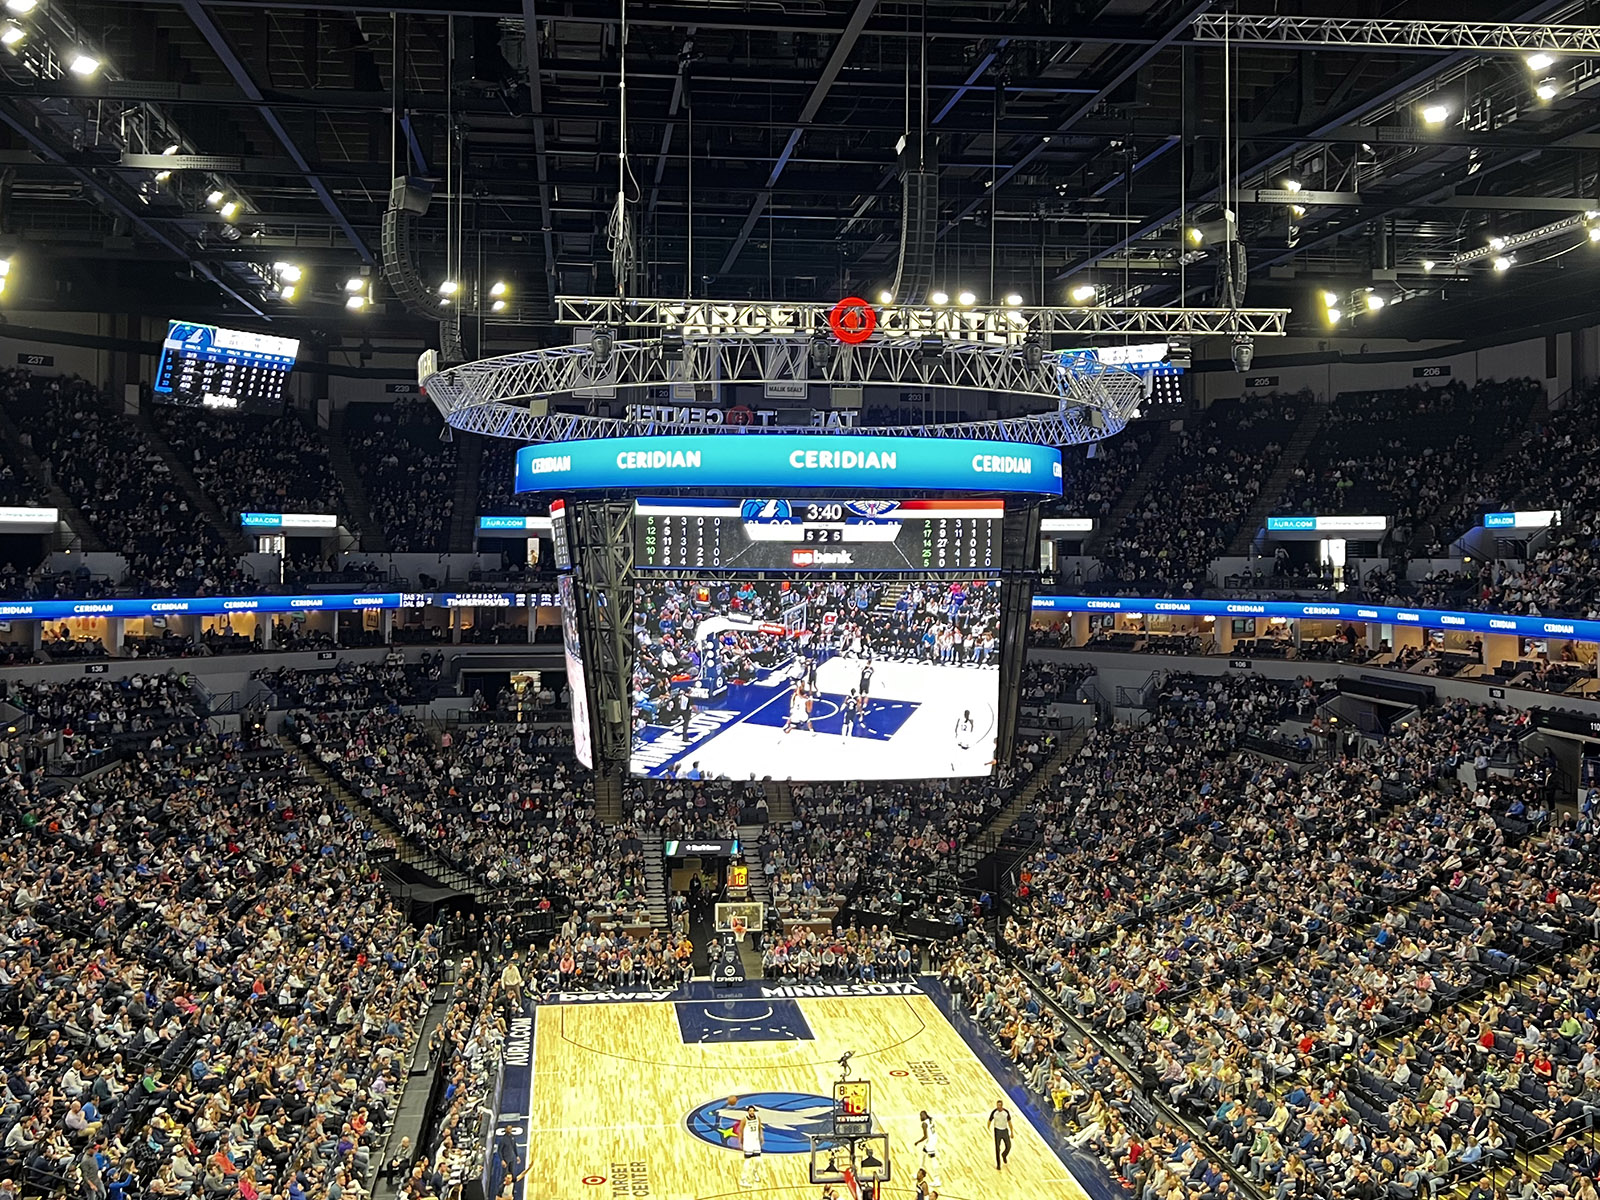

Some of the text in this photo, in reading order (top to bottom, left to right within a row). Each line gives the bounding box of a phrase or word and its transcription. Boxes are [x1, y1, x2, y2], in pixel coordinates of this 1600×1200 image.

[660, 305, 1029, 345] TARGET CENTER
[28, 355, 43, 364] 237
[1423, 368, 1440, 376] 206
[1255, 378, 1270, 386] 205
[616, 450, 701, 470] CERIDIAN
[789, 449, 897, 470] CERIDIAN
[972, 454, 1031, 474] CERIDIAN
[531, 455, 571, 474] CERIDIAN
[807, 504, 842, 520] 3:40
[245, 516, 280, 525] AURA.COM
[648, 517, 721, 525] 5 4 3 0 0
[924, 519, 992, 528] 2 2 3 1 1
[1273, 519, 1313, 528] AURA.COM
[1488, 517, 1513, 525] AURA.COM
[646, 526, 720, 536] 12 5 1 1 1
[806, 530, 840, 540] 5 2 5
[923, 530, 991, 538] 17 9 11 1 1
[645, 536, 719, 546] 32 11 3 1 1
[923, 539, 991, 547] 14 27 4 0 1
[646, 547, 721, 556] 10 5 0 2 0
[922, 549, 992, 557] 25 5 4 0 2
[648, 557, 720, 566] 1 6 4 2 0
[923, 559, 991, 567] 5 0 1 2 0
[223, 600, 258, 609] CERIDIAN
[290, 599, 323, 607] CERIDIAN
[353, 597, 383, 606] CERIDIAN
[446, 598, 509, 607] TIMBERWOLVES
[1087, 601, 1121, 609] CERIDIAN
[73, 604, 114, 613] CERIDIAN
[151, 602, 188, 611] CERIDIAN
[1155, 603, 1190, 611] CERIDIAN
[1227, 604, 1264, 613] CERIDIAN
[1303, 606, 1339, 615] CERIDIAN
[1357, 609, 1378, 618] CERIDIAN
[1397, 612, 1419, 622] CERIDIAN
[1440, 615, 1466, 625] CERIDIAN
[1489, 619, 1516, 629] CERIDIAN
[1543, 623, 1574, 634] CERIDIAN
[736, 874, 746, 885] 18
[761, 983, 925, 998] MINNESOTA
[559, 991, 672, 1001] betway
[611, 1162, 630, 1198] TARGET
[630, 1161, 650, 1197] CENTER
